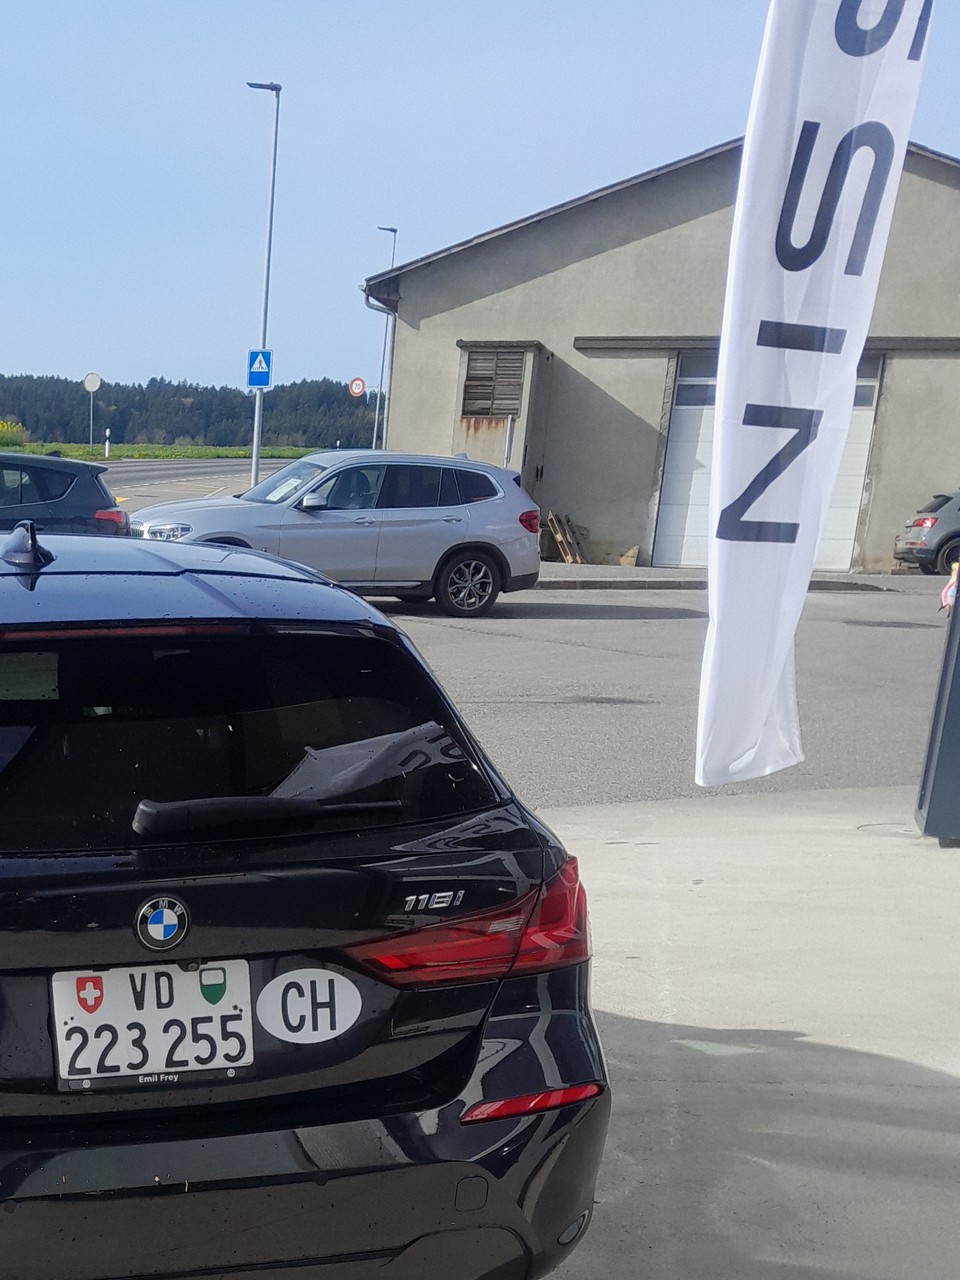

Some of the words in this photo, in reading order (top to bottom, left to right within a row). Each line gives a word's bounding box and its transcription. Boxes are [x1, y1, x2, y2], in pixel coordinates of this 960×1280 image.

[143, 899, 184, 918] BMW
[404, 890, 465, 911] 118i
[129, 971, 175, 1011] VD
[281, 979, 337, 1033] CH
[64, 1022, 149, 1076] 223
[162, 1014, 247, 1068] 255
[138, 1074, 158, 1083] Emil
[160, 1074, 179, 1083] Frey
